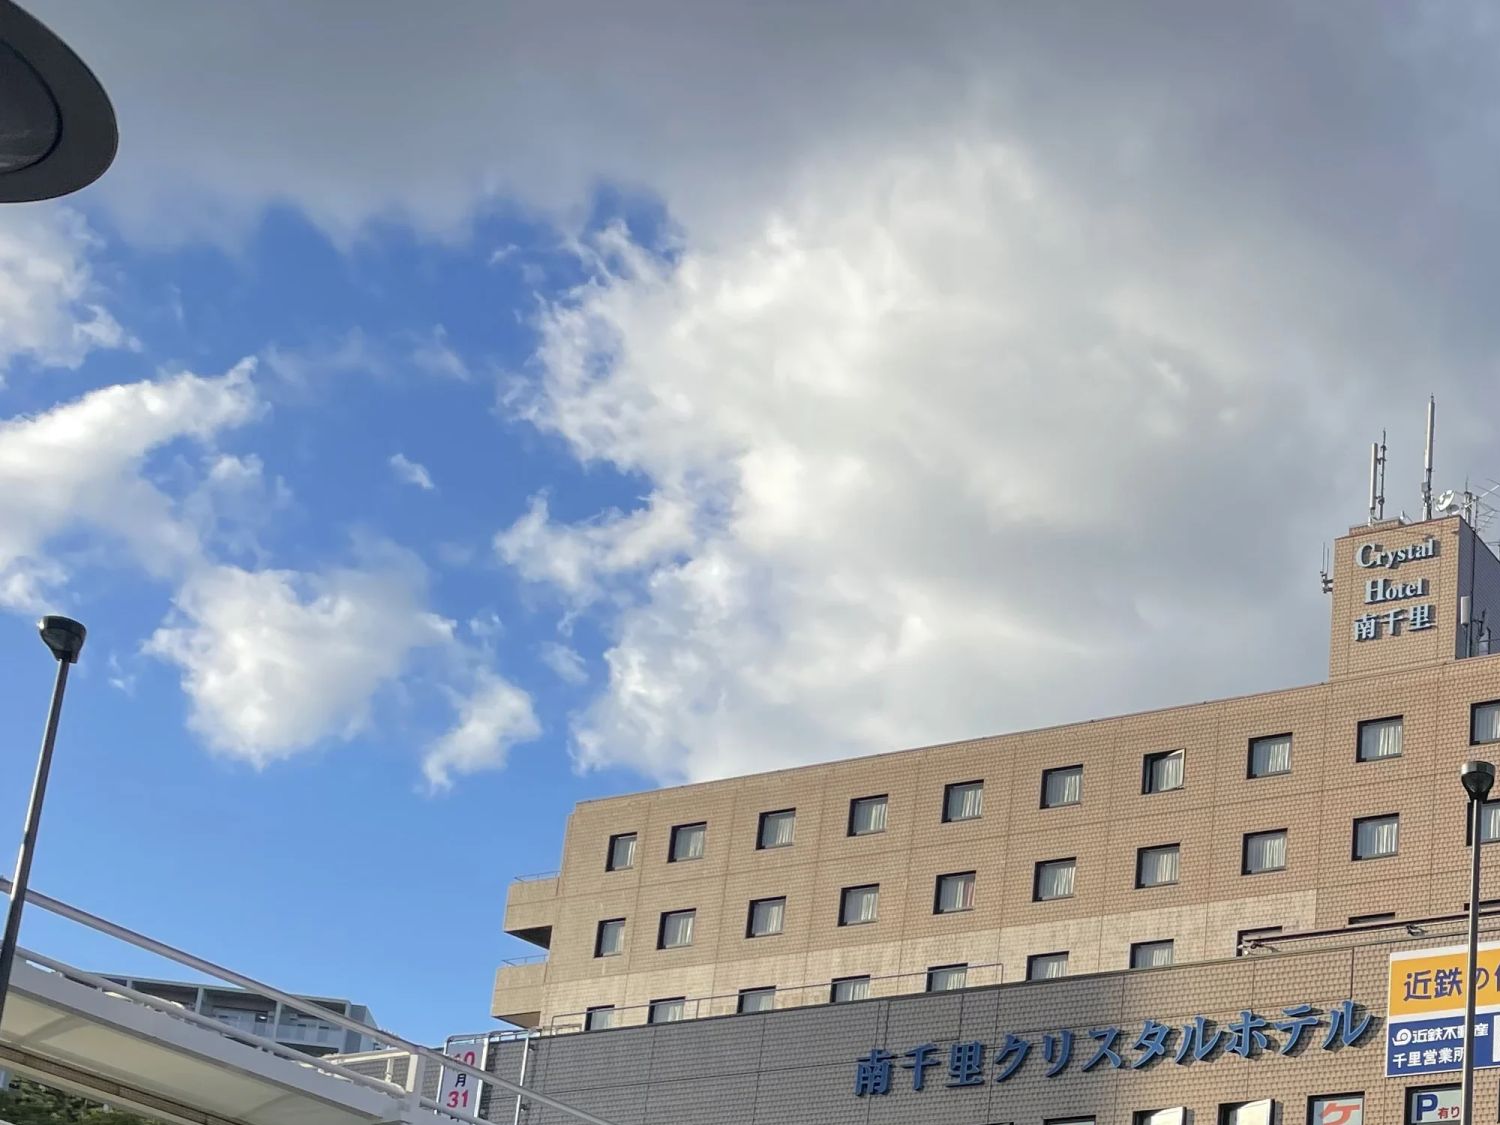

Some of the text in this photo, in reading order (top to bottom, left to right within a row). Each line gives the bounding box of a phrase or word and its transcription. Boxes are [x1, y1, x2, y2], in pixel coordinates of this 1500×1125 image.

[1355, 538, 1435, 568] Crystal
[1364, 577, 1424, 604] Hotel
[1353, 603, 1436, 641] 南千里
[854, 1000, 1372, 1097] 南千里クリスタルホテル
[1416, 1094, 1460, 1122] P 有り
